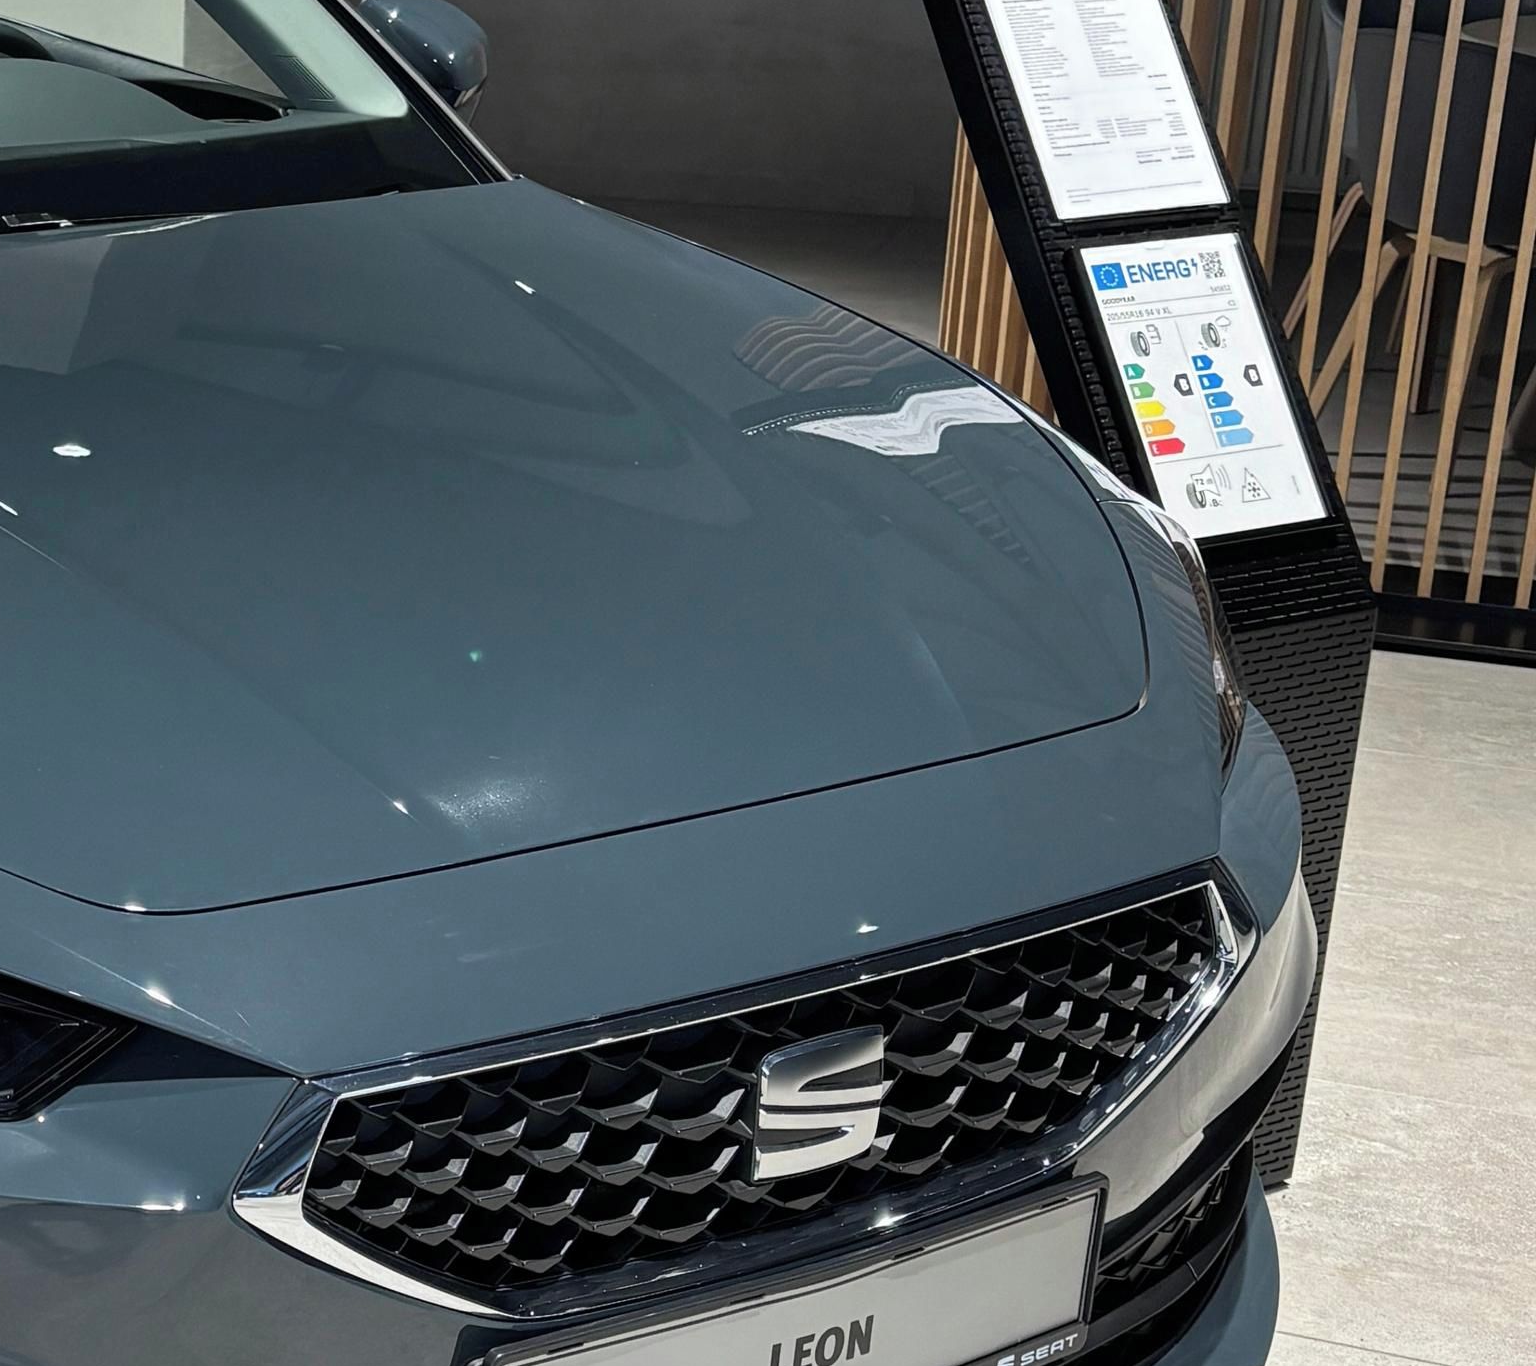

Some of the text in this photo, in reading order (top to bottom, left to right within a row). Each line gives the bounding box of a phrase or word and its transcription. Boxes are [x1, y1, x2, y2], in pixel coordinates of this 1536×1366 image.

[1126, 259, 1192, 284] ENERG
[1196, 358, 1204, 368] A
[1127, 368, 1136, 377] A
[1178, 378, 1190, 391] B
[1152, 442, 1160, 454] E
[1020, 1333, 1078, 1366] SEAT
